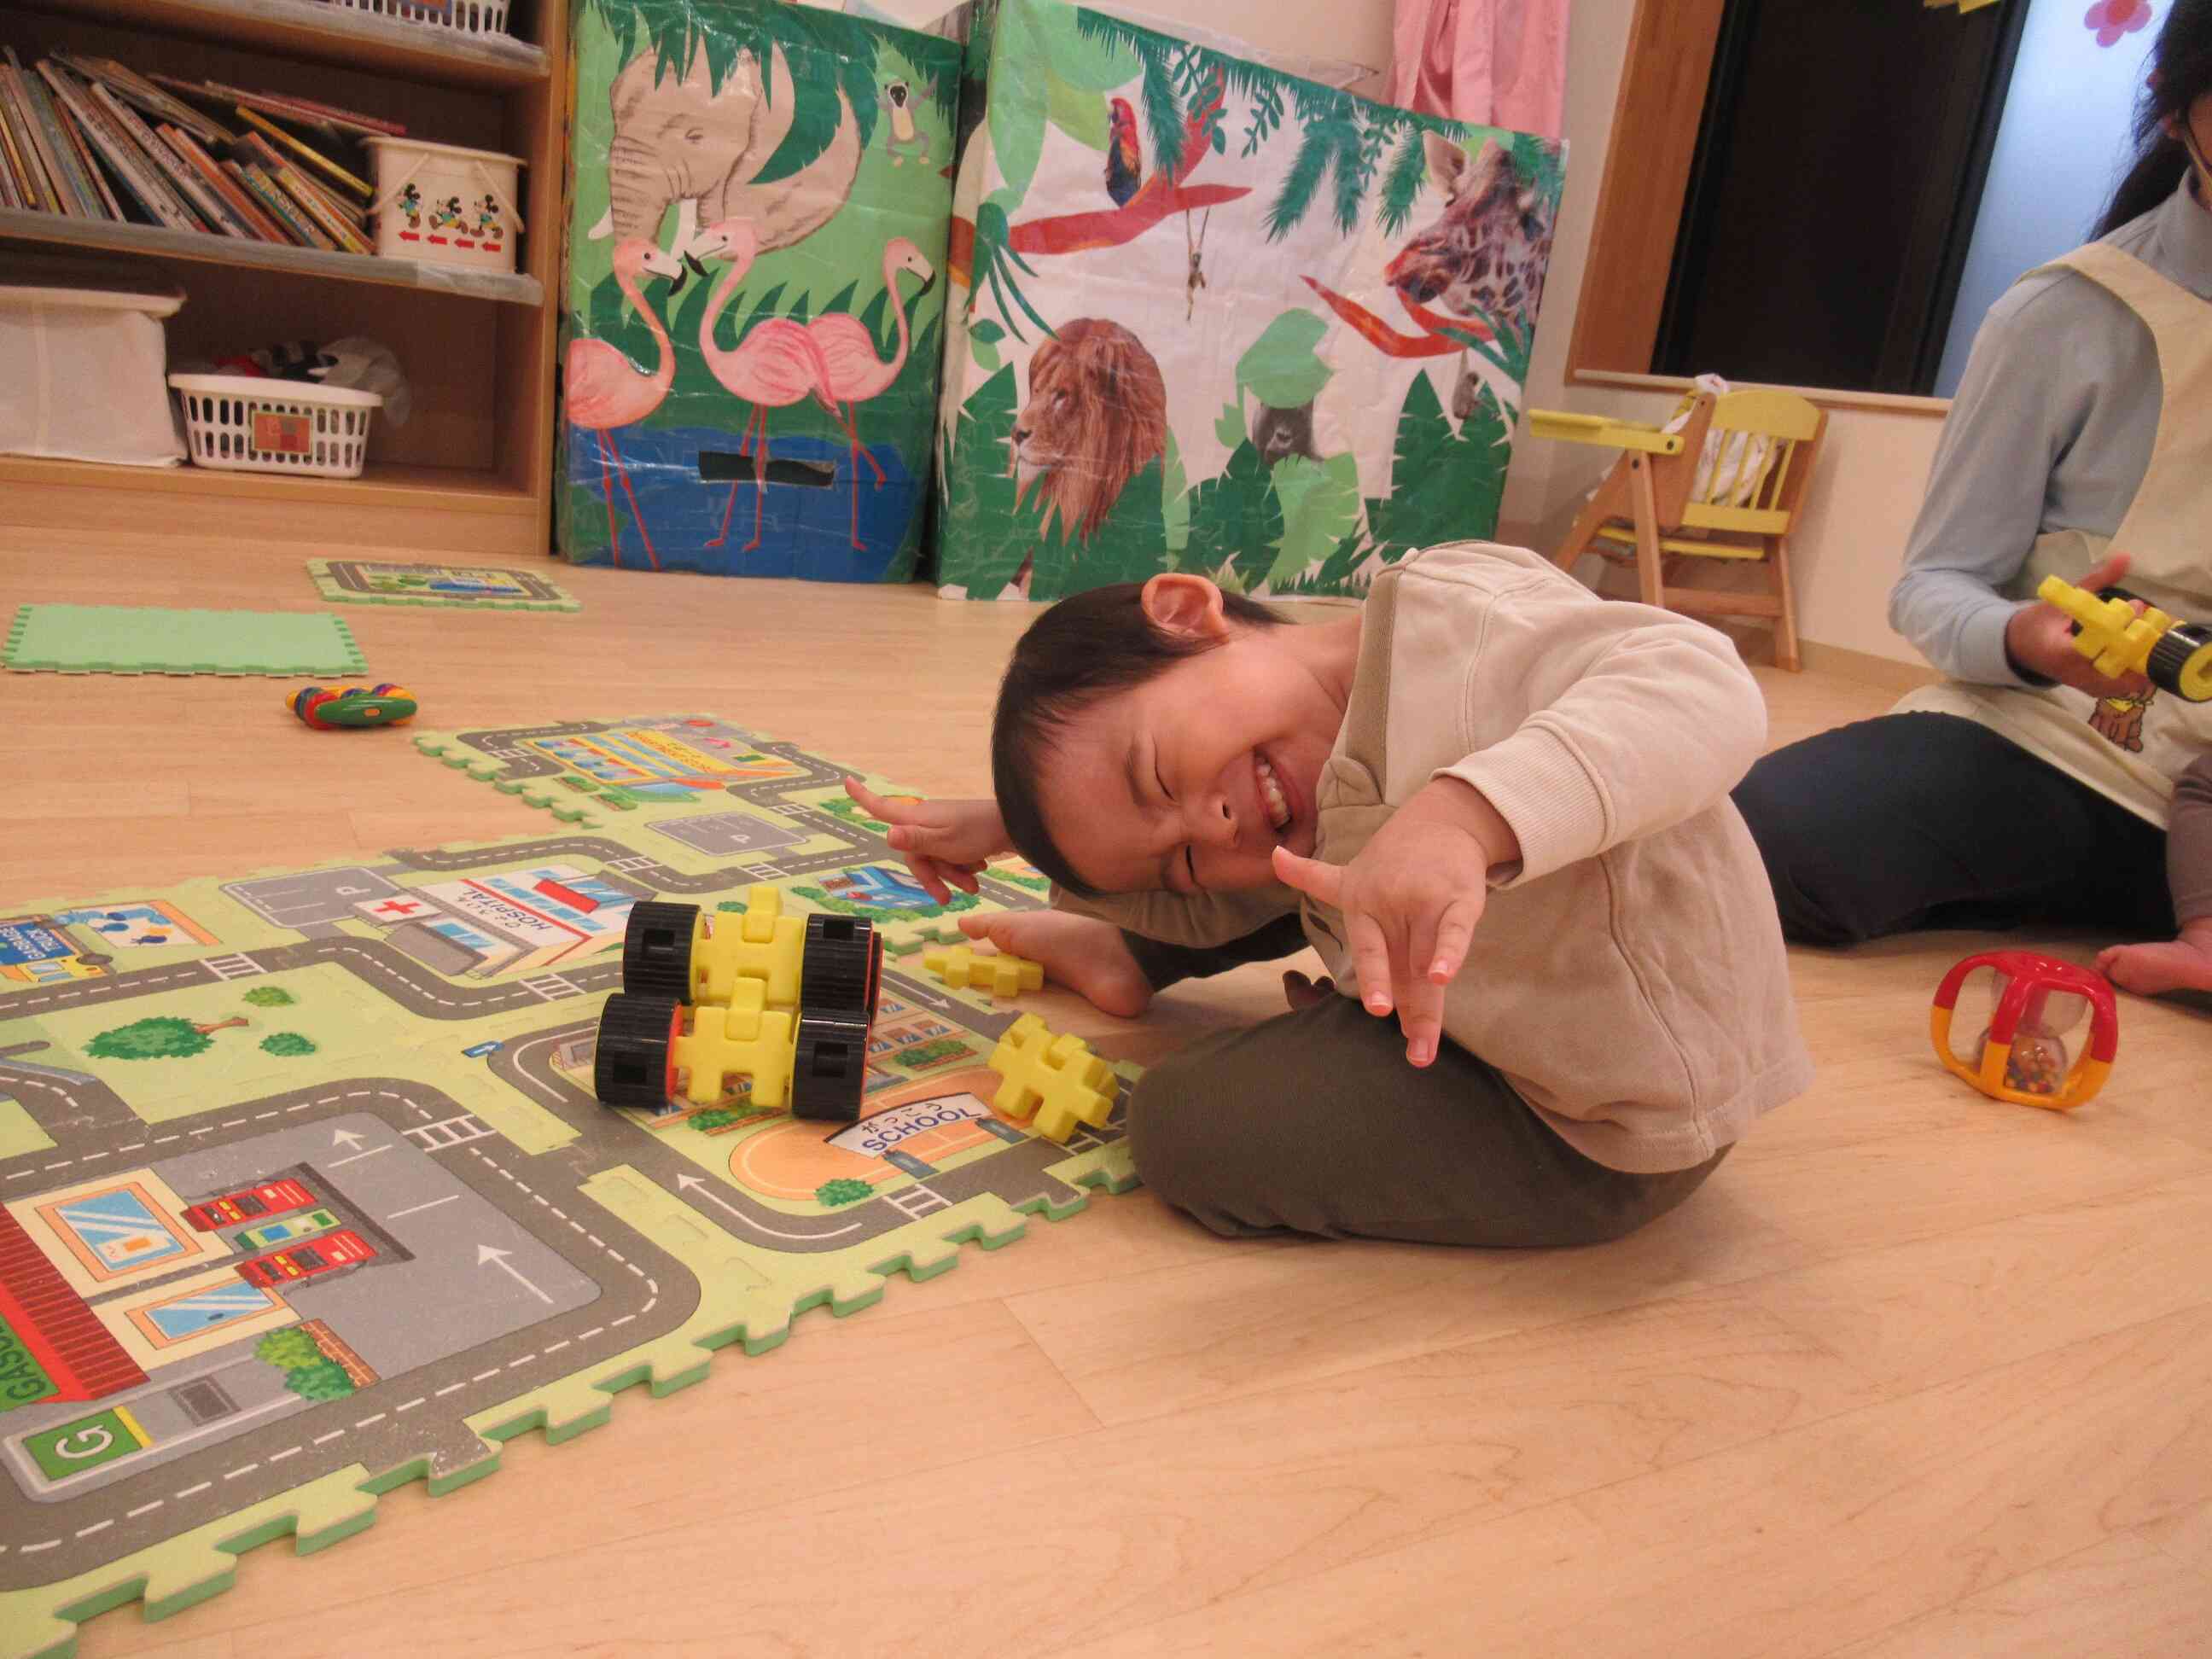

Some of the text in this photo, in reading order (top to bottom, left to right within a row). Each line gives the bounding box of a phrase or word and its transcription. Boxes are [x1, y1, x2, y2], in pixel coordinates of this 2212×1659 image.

[335, 886, 372, 896] P
[462, 888, 554, 932] HOSPITAL
[861, 1108, 982, 1151] SCHOOL
[55, 1423, 114, 1459] G
